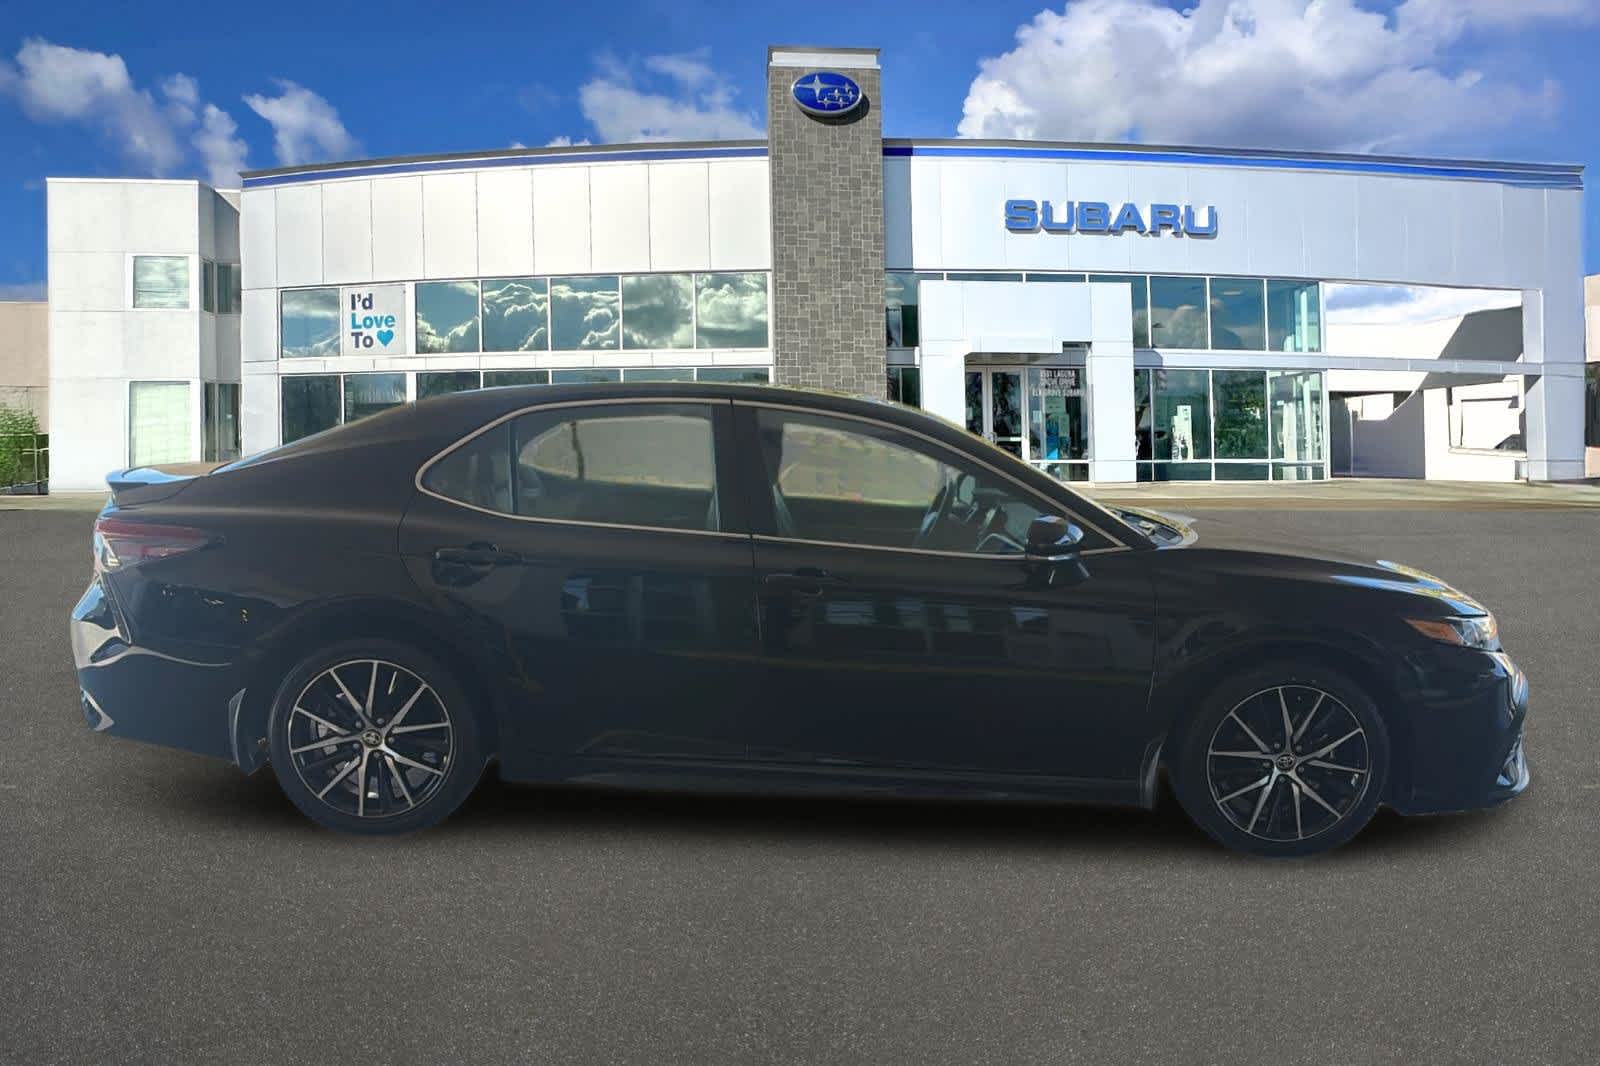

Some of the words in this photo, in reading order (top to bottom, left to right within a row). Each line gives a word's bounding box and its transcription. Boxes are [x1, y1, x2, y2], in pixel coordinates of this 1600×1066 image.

[1005, 199, 1218, 239] SUBARU
[351, 293, 373, 311] I’d
[351, 312, 396, 330] Love
[351, 331, 374, 349] To
